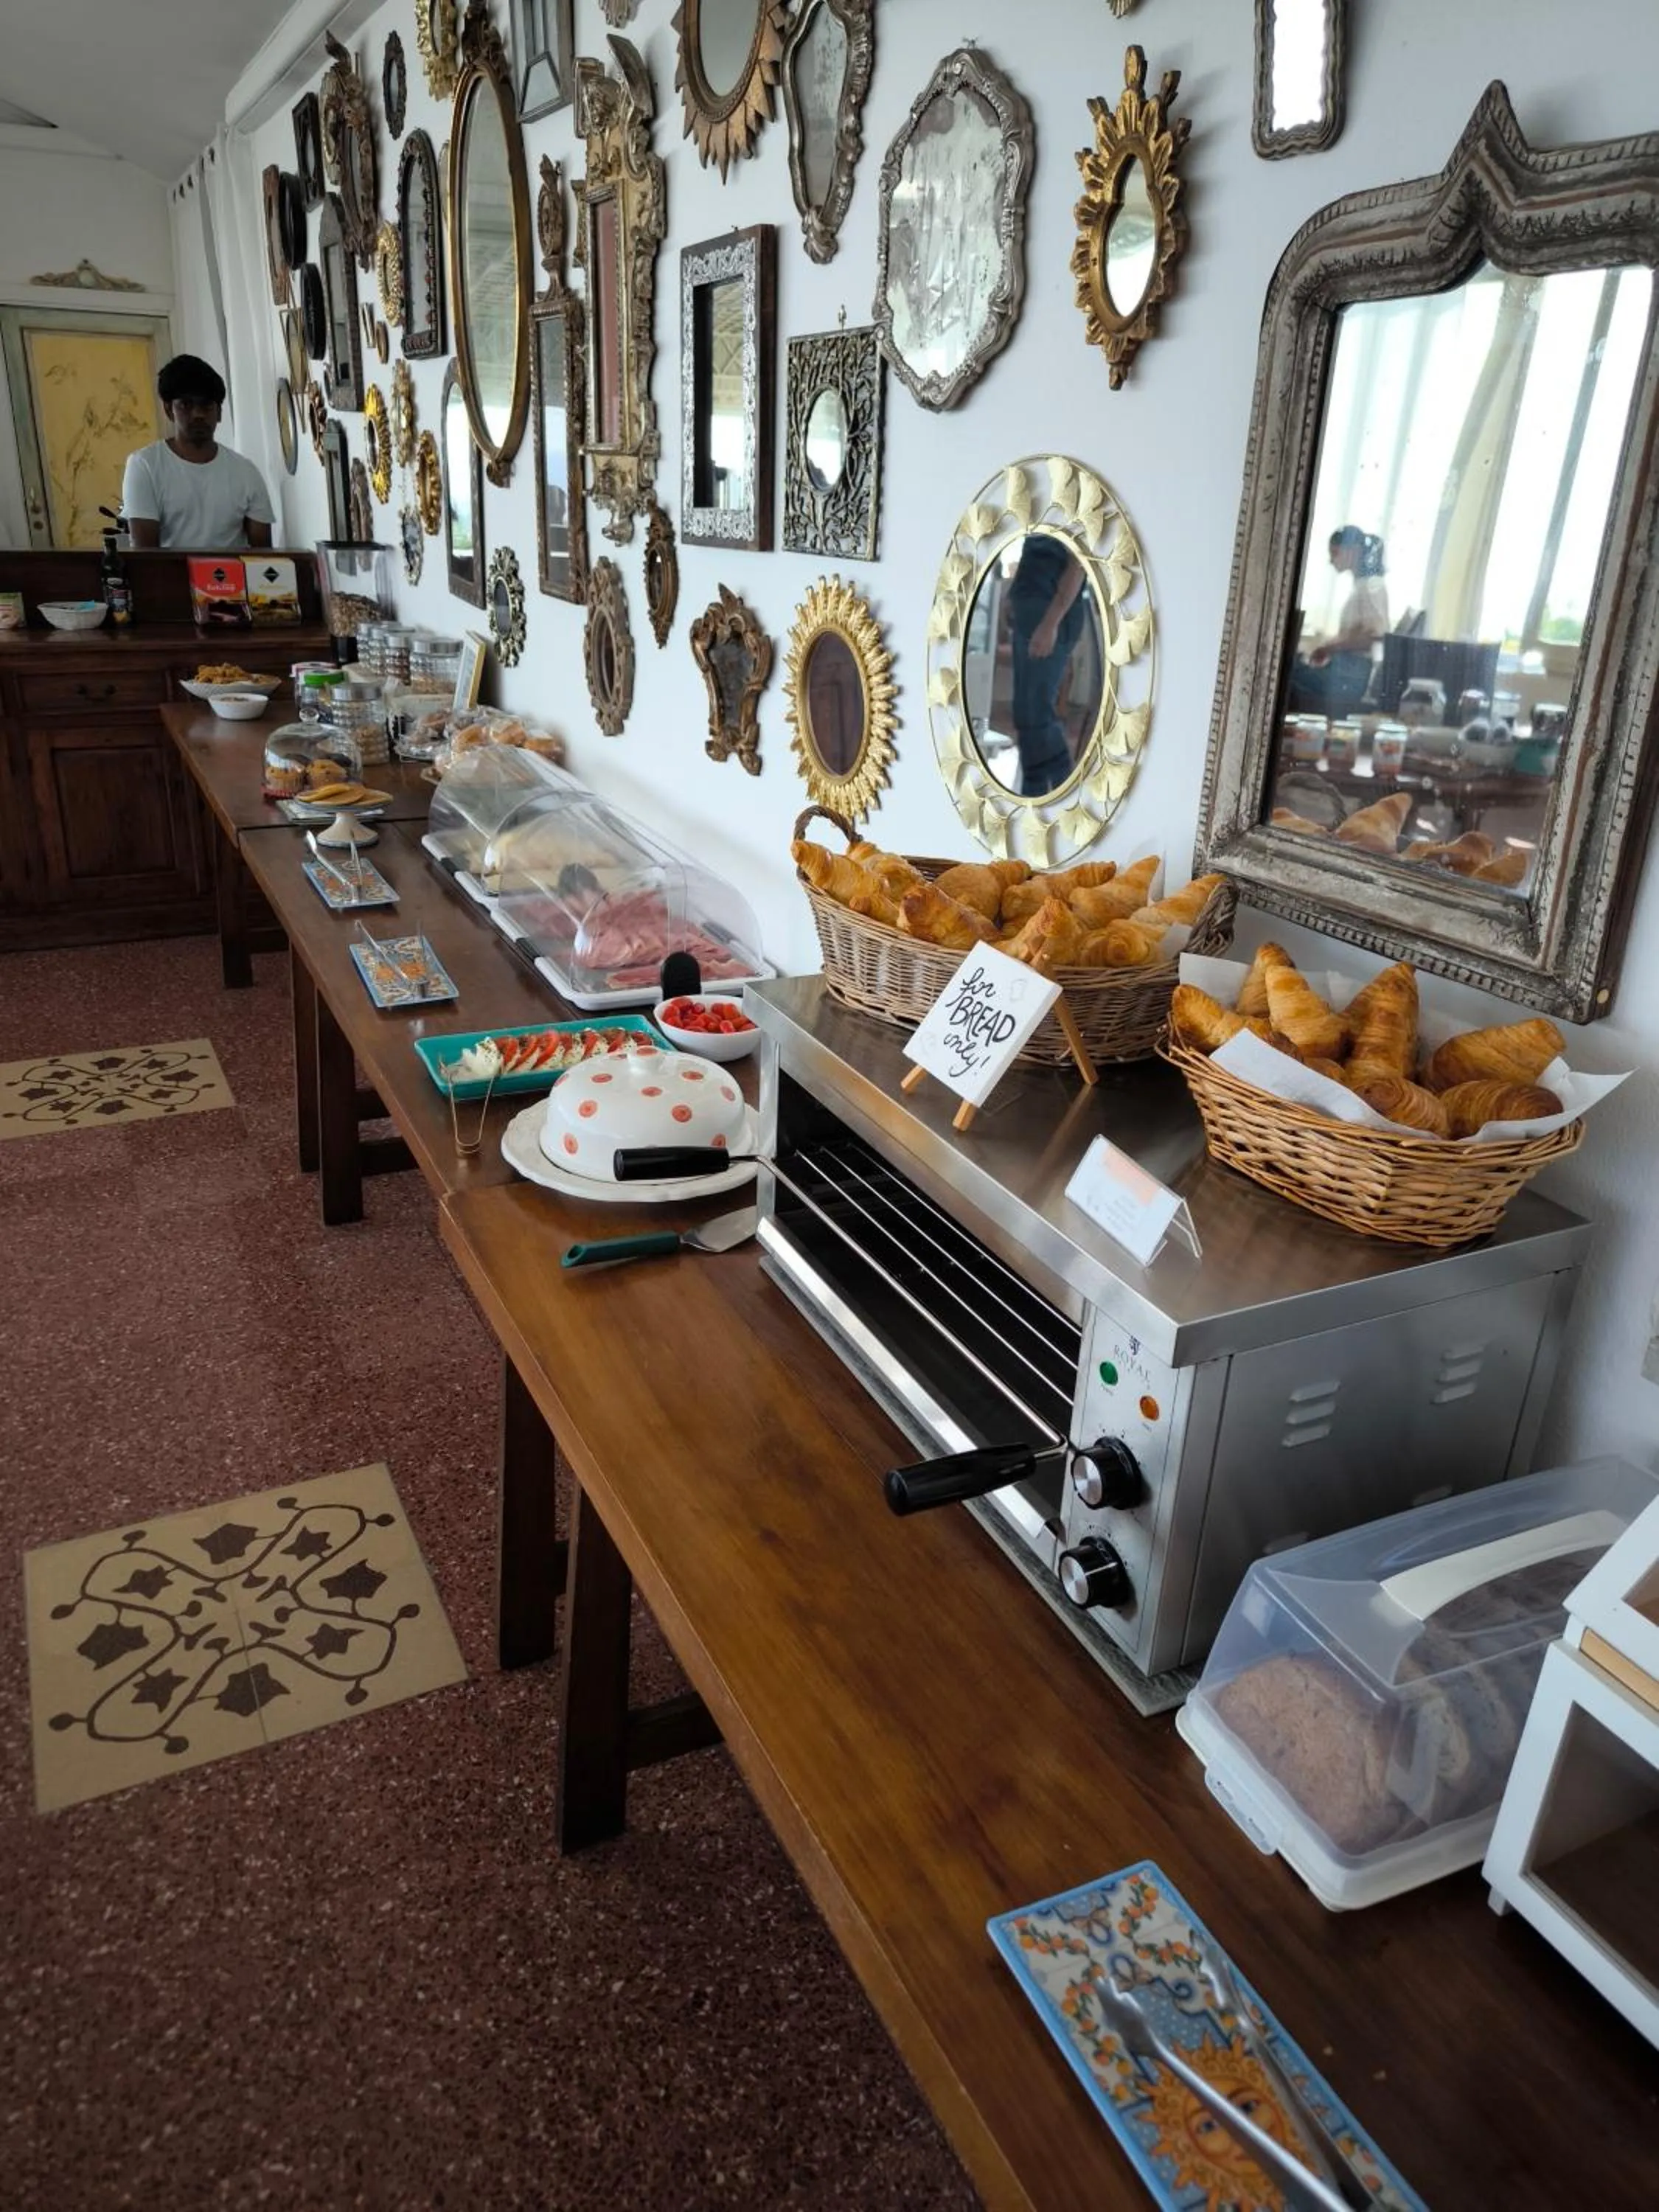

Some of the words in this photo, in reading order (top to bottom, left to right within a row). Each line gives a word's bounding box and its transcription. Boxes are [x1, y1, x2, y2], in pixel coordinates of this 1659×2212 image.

[945, 967, 995, 1007] for
[950, 996, 1015, 1047] BREAD
[944, 1032, 991, 1077] only!
